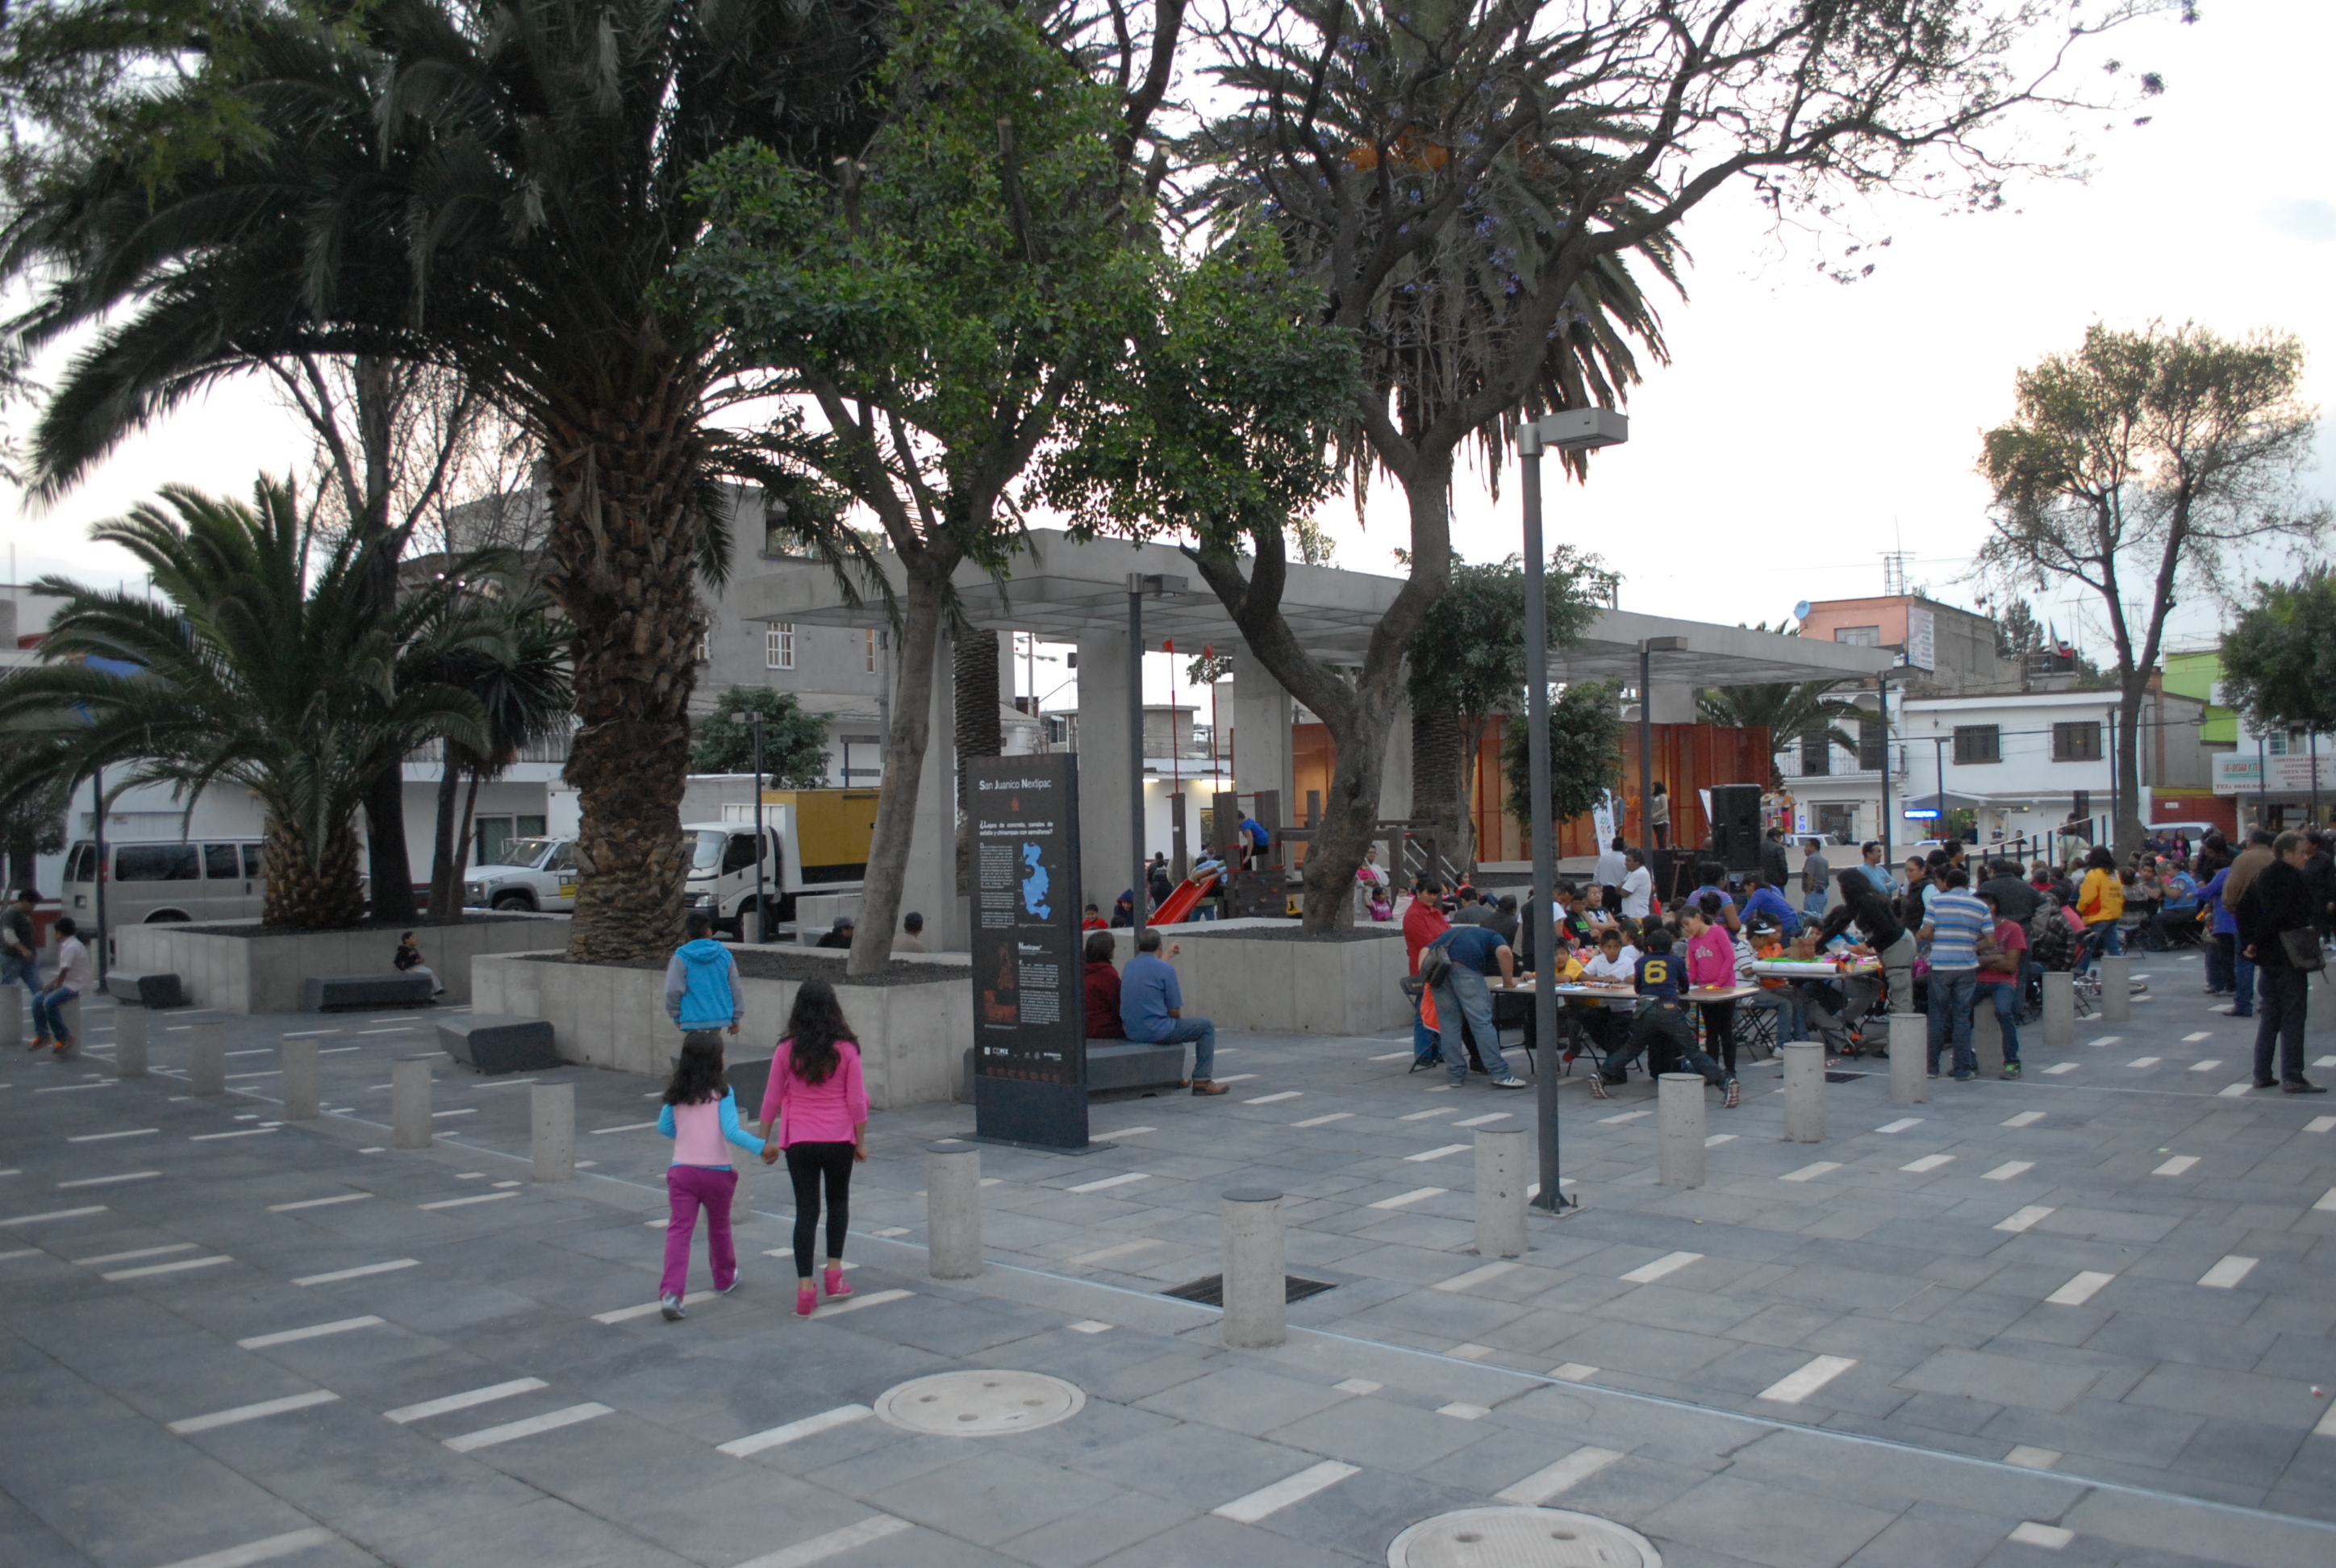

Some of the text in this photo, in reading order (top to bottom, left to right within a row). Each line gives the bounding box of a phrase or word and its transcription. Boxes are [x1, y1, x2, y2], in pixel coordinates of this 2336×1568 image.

[979, 778, 1052, 790] San Juanico Nextipac
[1645, 960, 1667, 983] 6
